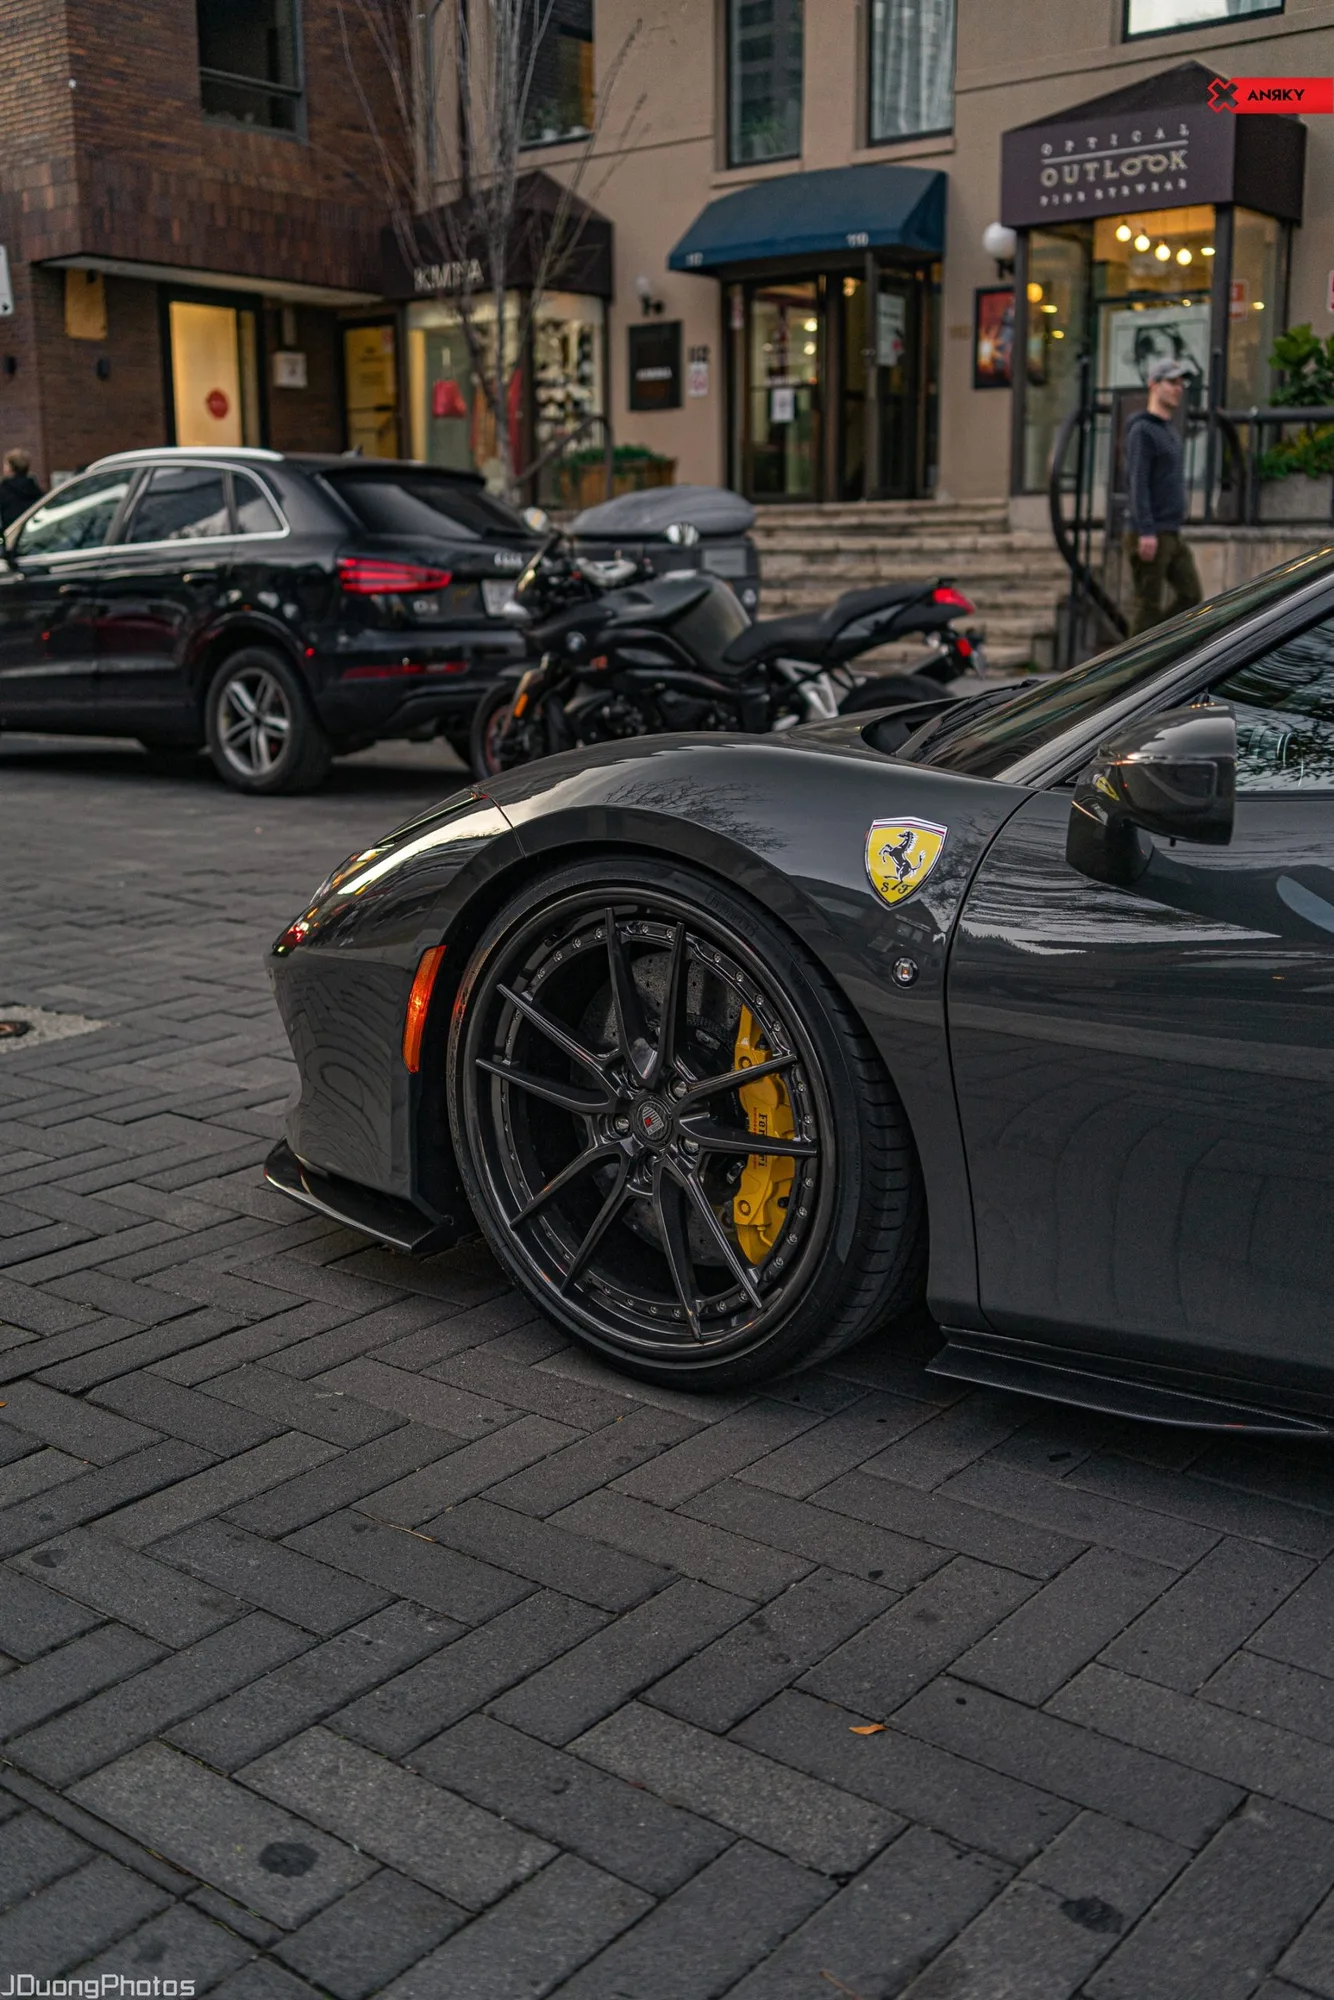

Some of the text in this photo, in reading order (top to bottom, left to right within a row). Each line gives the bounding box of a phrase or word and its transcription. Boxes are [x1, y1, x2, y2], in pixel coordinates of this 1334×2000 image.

[1041, 123, 1190, 157] OPTICAL
[1040, 149, 1188, 188] OUTLOOK
[881, 881, 890, 894] S
